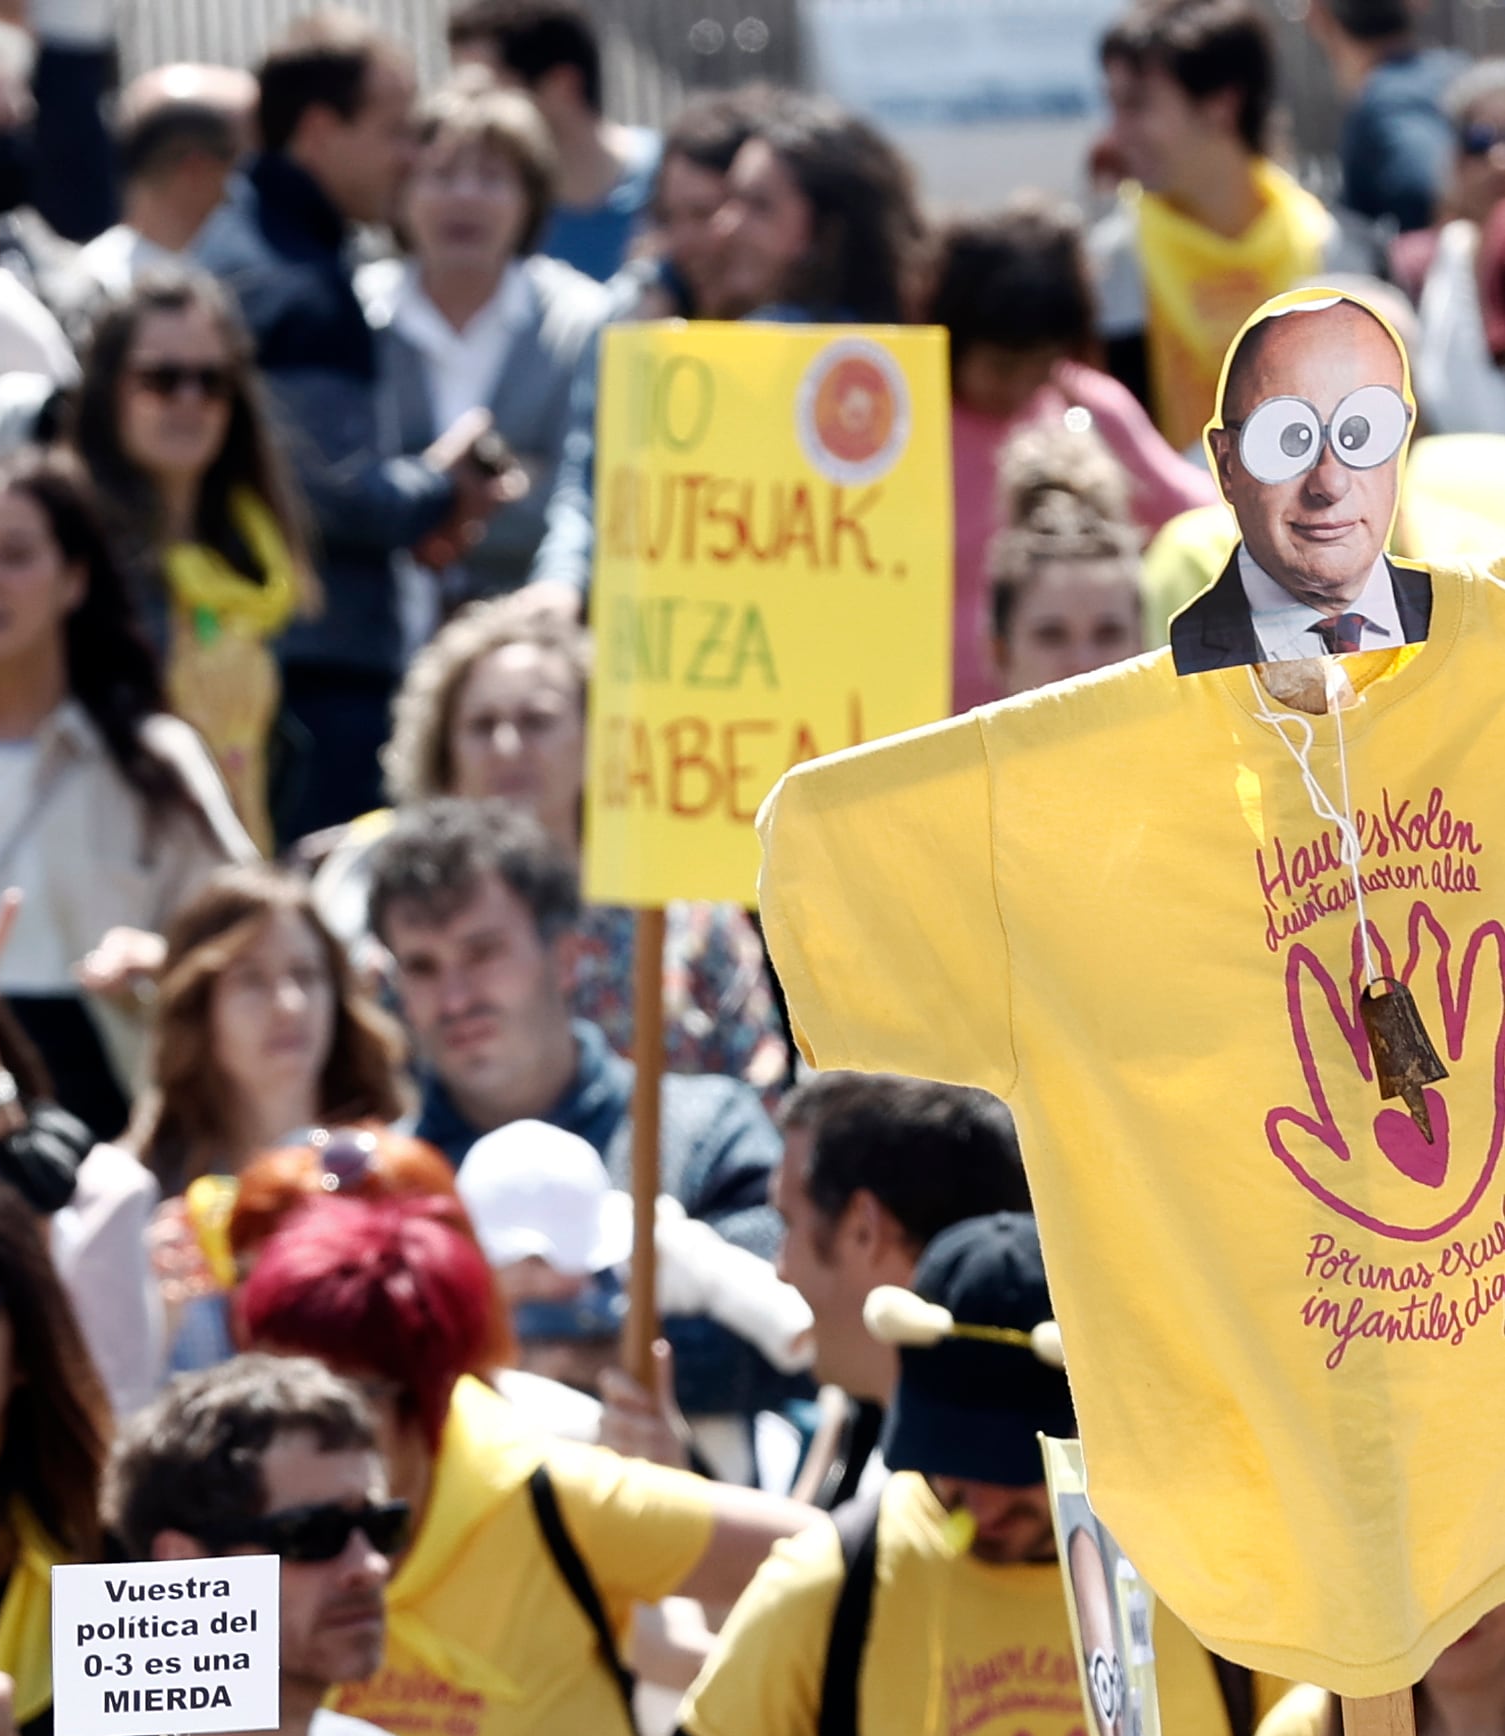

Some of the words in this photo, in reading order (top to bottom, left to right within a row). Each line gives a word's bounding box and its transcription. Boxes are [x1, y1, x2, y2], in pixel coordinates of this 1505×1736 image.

[604, 463, 908, 580] UTSUAK.
[1432, 853, 1481, 893] alde
[1305, 1233, 1361, 1285] Por
[1358, 1262, 1434, 1291] unas
[1300, 1287, 1465, 1369] infantiles
[105, 1577, 230, 1602] Vuestra
[77, 1615, 198, 1646] política
[210, 1609, 257, 1634] del
[84, 1653, 133, 1677] 0-3
[145, 1657, 181, 1675] es
[194, 1652, 250, 1672] una
[103, 1685, 232, 1713] MIERDA
